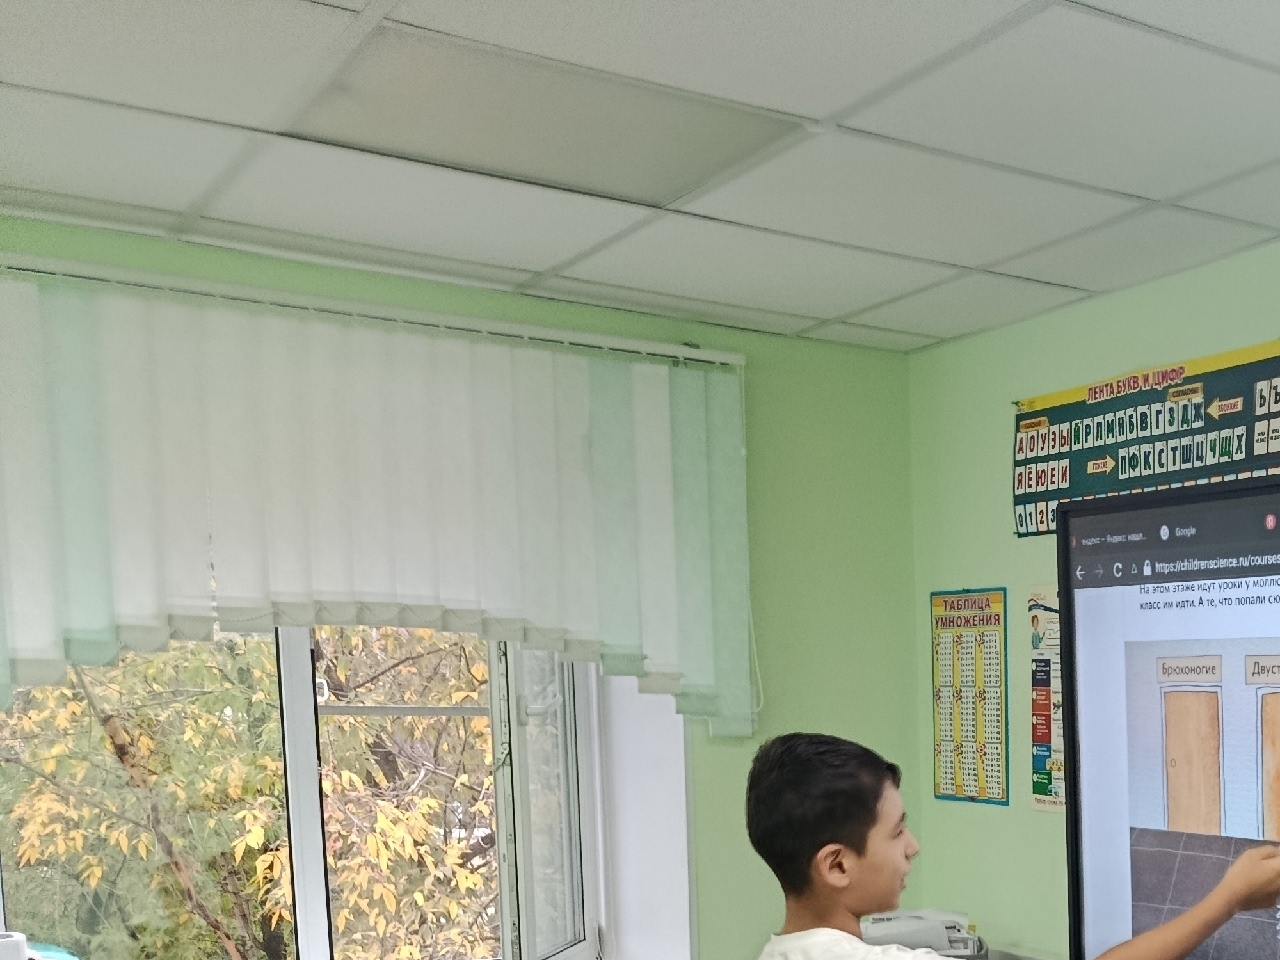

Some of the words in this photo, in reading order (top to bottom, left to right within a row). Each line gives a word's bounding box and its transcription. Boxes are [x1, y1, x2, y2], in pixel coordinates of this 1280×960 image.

[1087, 382, 1114, 401] ЛЕНТА
[1116, 375, 1140, 394] БУКВ
[1143, 373, 1149, 388] И
[1153, 366, 1185, 388] ЦИФР
[1175, 526, 1197, 537] Google
[1140, 584, 1150, 595] На
[1152, 585, 1170, 594] этом
[1172, 583, 1195, 593] этаже
[1197, 581, 1215, 593] идут
[1218, 580, 1242, 593] уроки
[1245, 579, 1250, 591] у
[943, 597, 991, 611] ТАБЛИЦА
[1140, 601, 1161, 610] класс
[1163, 600, 1173, 609] им
[1199, 596, 1204, 606] А
[1207, 599, 1217, 608] те,
[1219, 597, 1232, 606] что
[1235, 595, 1266, 606] попали
[935, 614, 1000, 628] УМНОЖЕНИЯ
[1162, 662, 1216, 677] Брюхоногие
